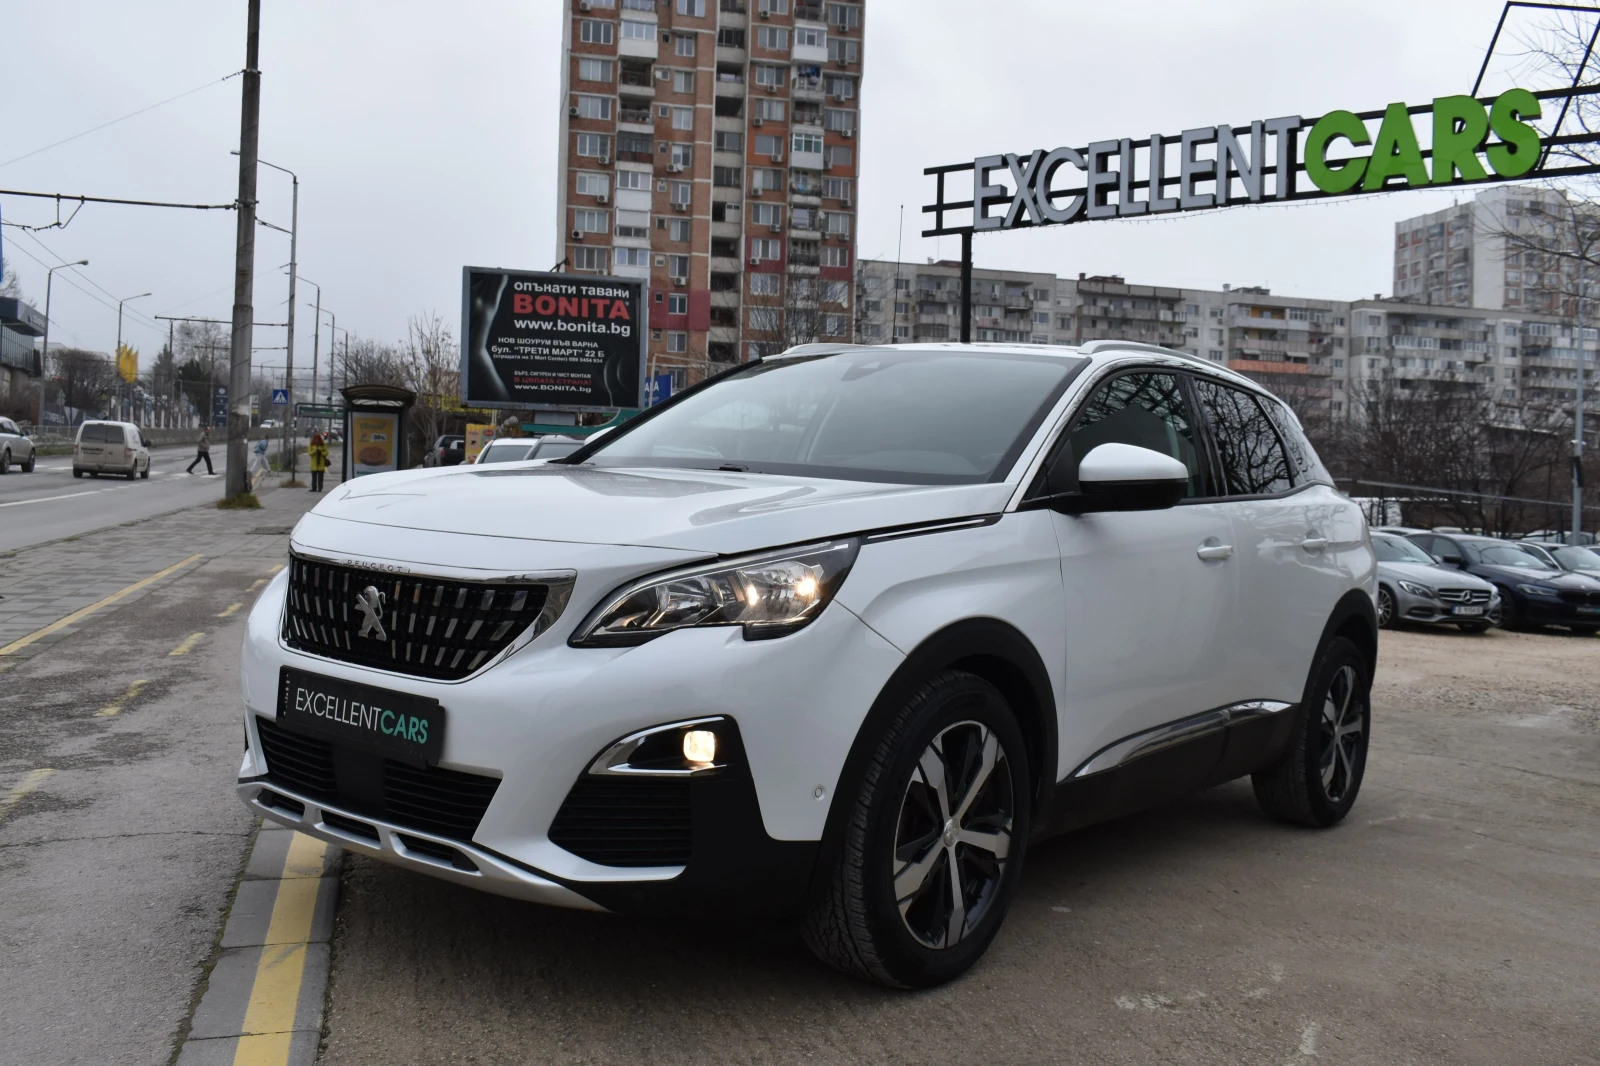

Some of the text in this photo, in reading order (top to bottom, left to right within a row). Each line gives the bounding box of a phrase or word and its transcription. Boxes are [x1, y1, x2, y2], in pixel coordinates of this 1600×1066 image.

[514, 282, 629, 298] опънати тавани
[513, 294, 629, 320] BONITA
[514, 319, 631, 337] www.bonita.bg
[517, 338, 551, 346] ШОУРУМ
[572, 340, 599, 348] ВАРНА
[491, 345, 511, 354] бул.
[597, 350, 605, 358] Б
[514, 384, 592, 393] www.BONITA.bg
[347, 559, 403, 572] PEUGEOT
